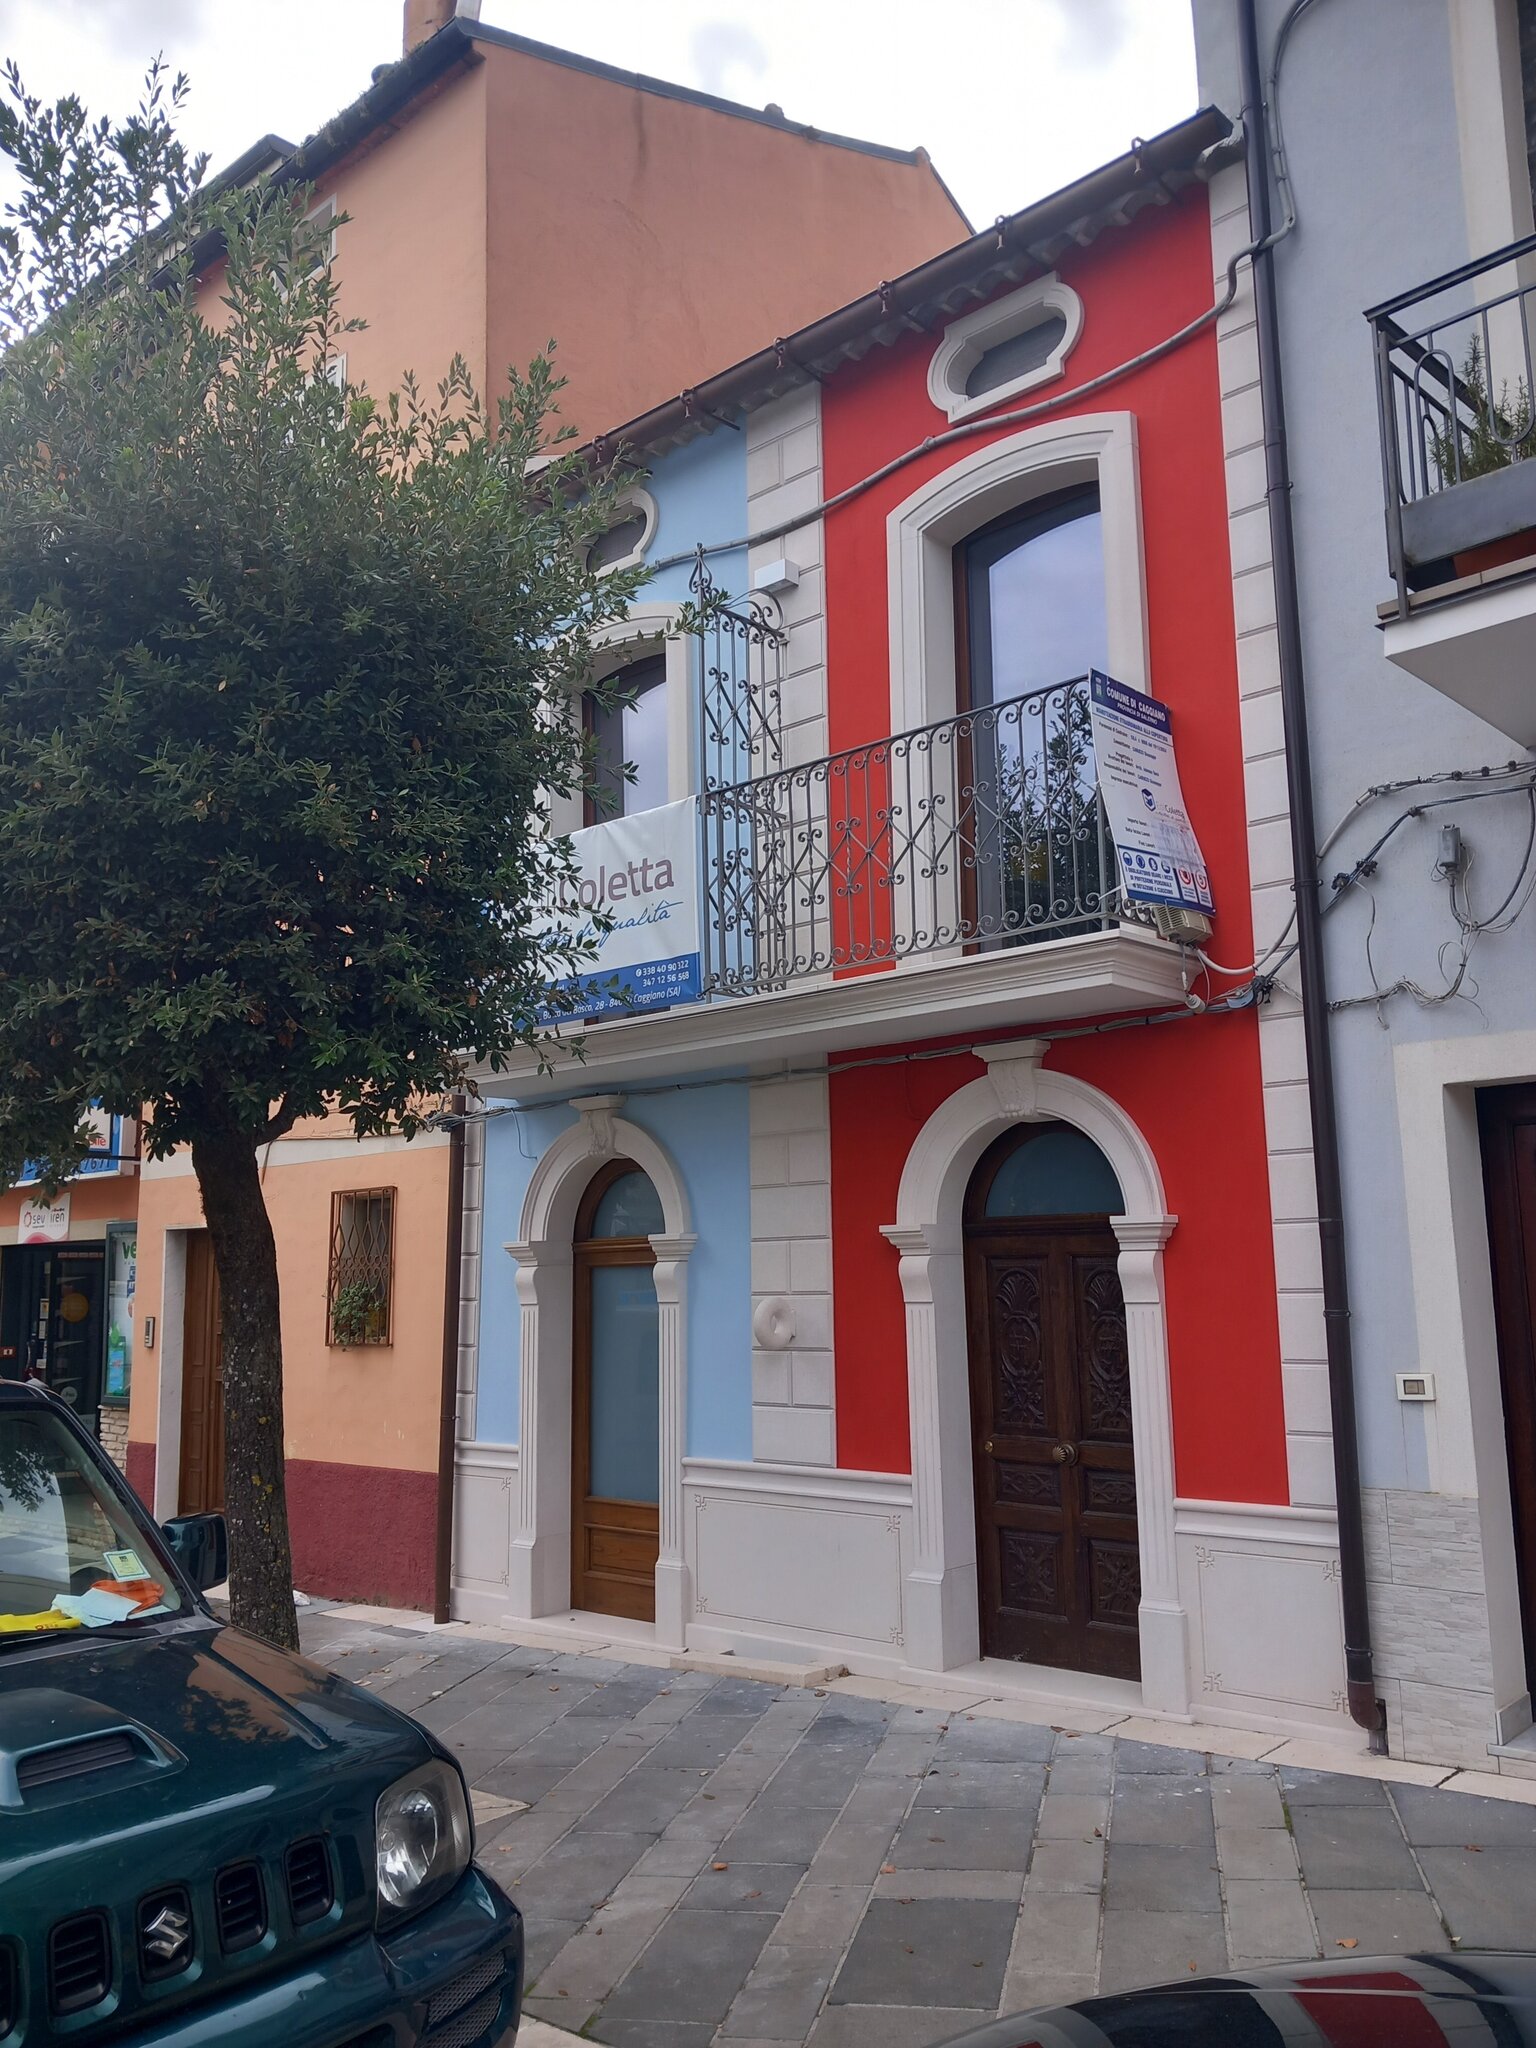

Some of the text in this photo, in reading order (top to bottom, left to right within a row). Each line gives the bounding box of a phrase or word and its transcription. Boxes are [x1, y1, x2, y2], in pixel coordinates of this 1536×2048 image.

[1106, 686, 1166, 722] COMUNE DI CAGGIANO
[642, 966, 655, 976] 338
[657, 964, 666, 973] 40
[642, 978, 655, 987] 347
[657, 975, 666, 984] 12
[667, 974, 677, 982] 56
[595, 1000, 605, 1011] 28
[666, 985, 681, 999] (SA)
